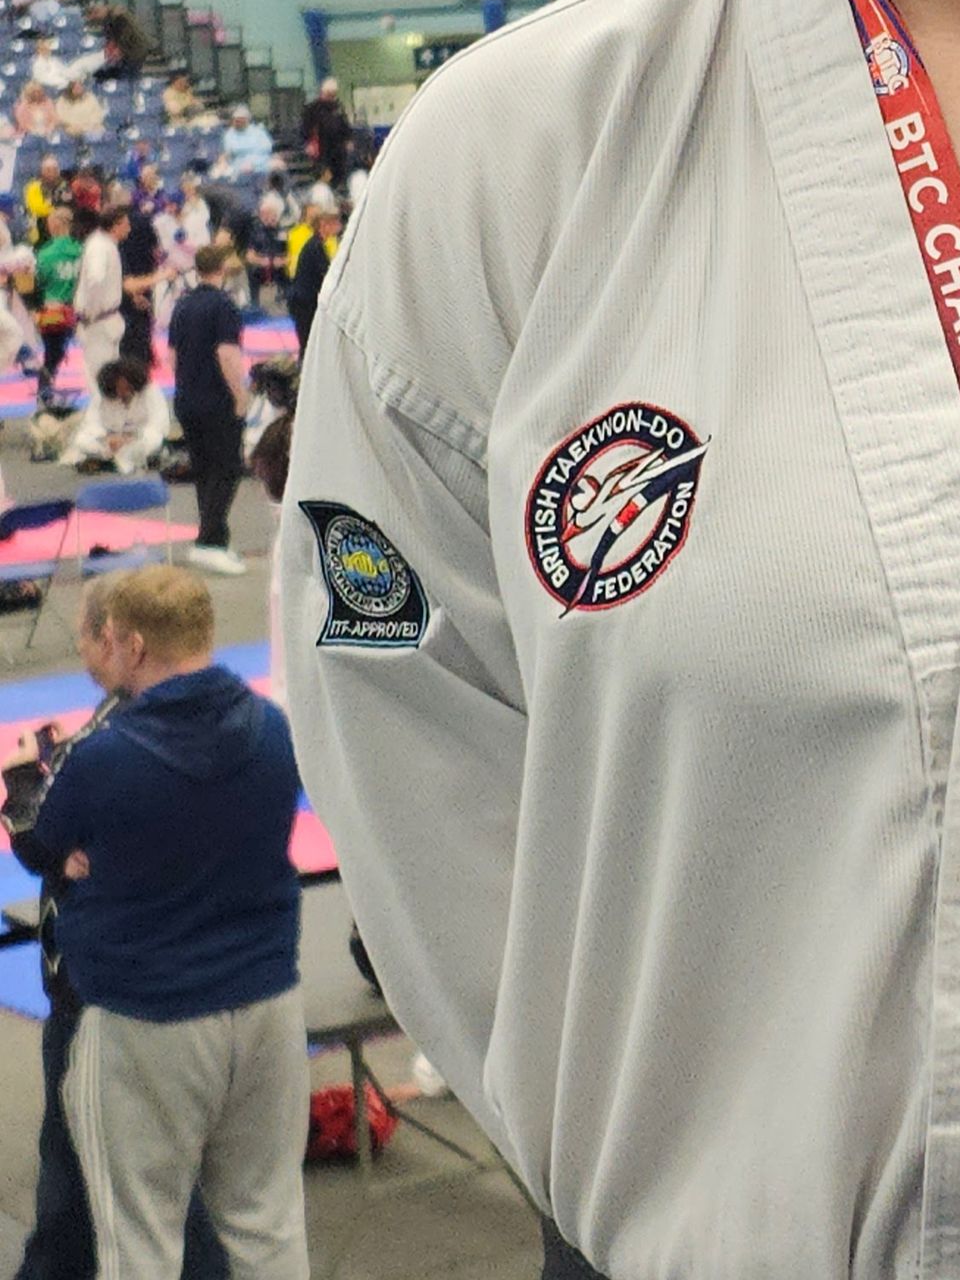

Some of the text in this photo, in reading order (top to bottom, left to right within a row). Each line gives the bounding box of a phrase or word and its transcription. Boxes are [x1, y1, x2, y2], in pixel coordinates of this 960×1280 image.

[886, 111, 949, 214] BTC
[535, 409, 684, 588] BRITISH TAEKWON-DO
[592, 481, 694, 602] FEDERATION
